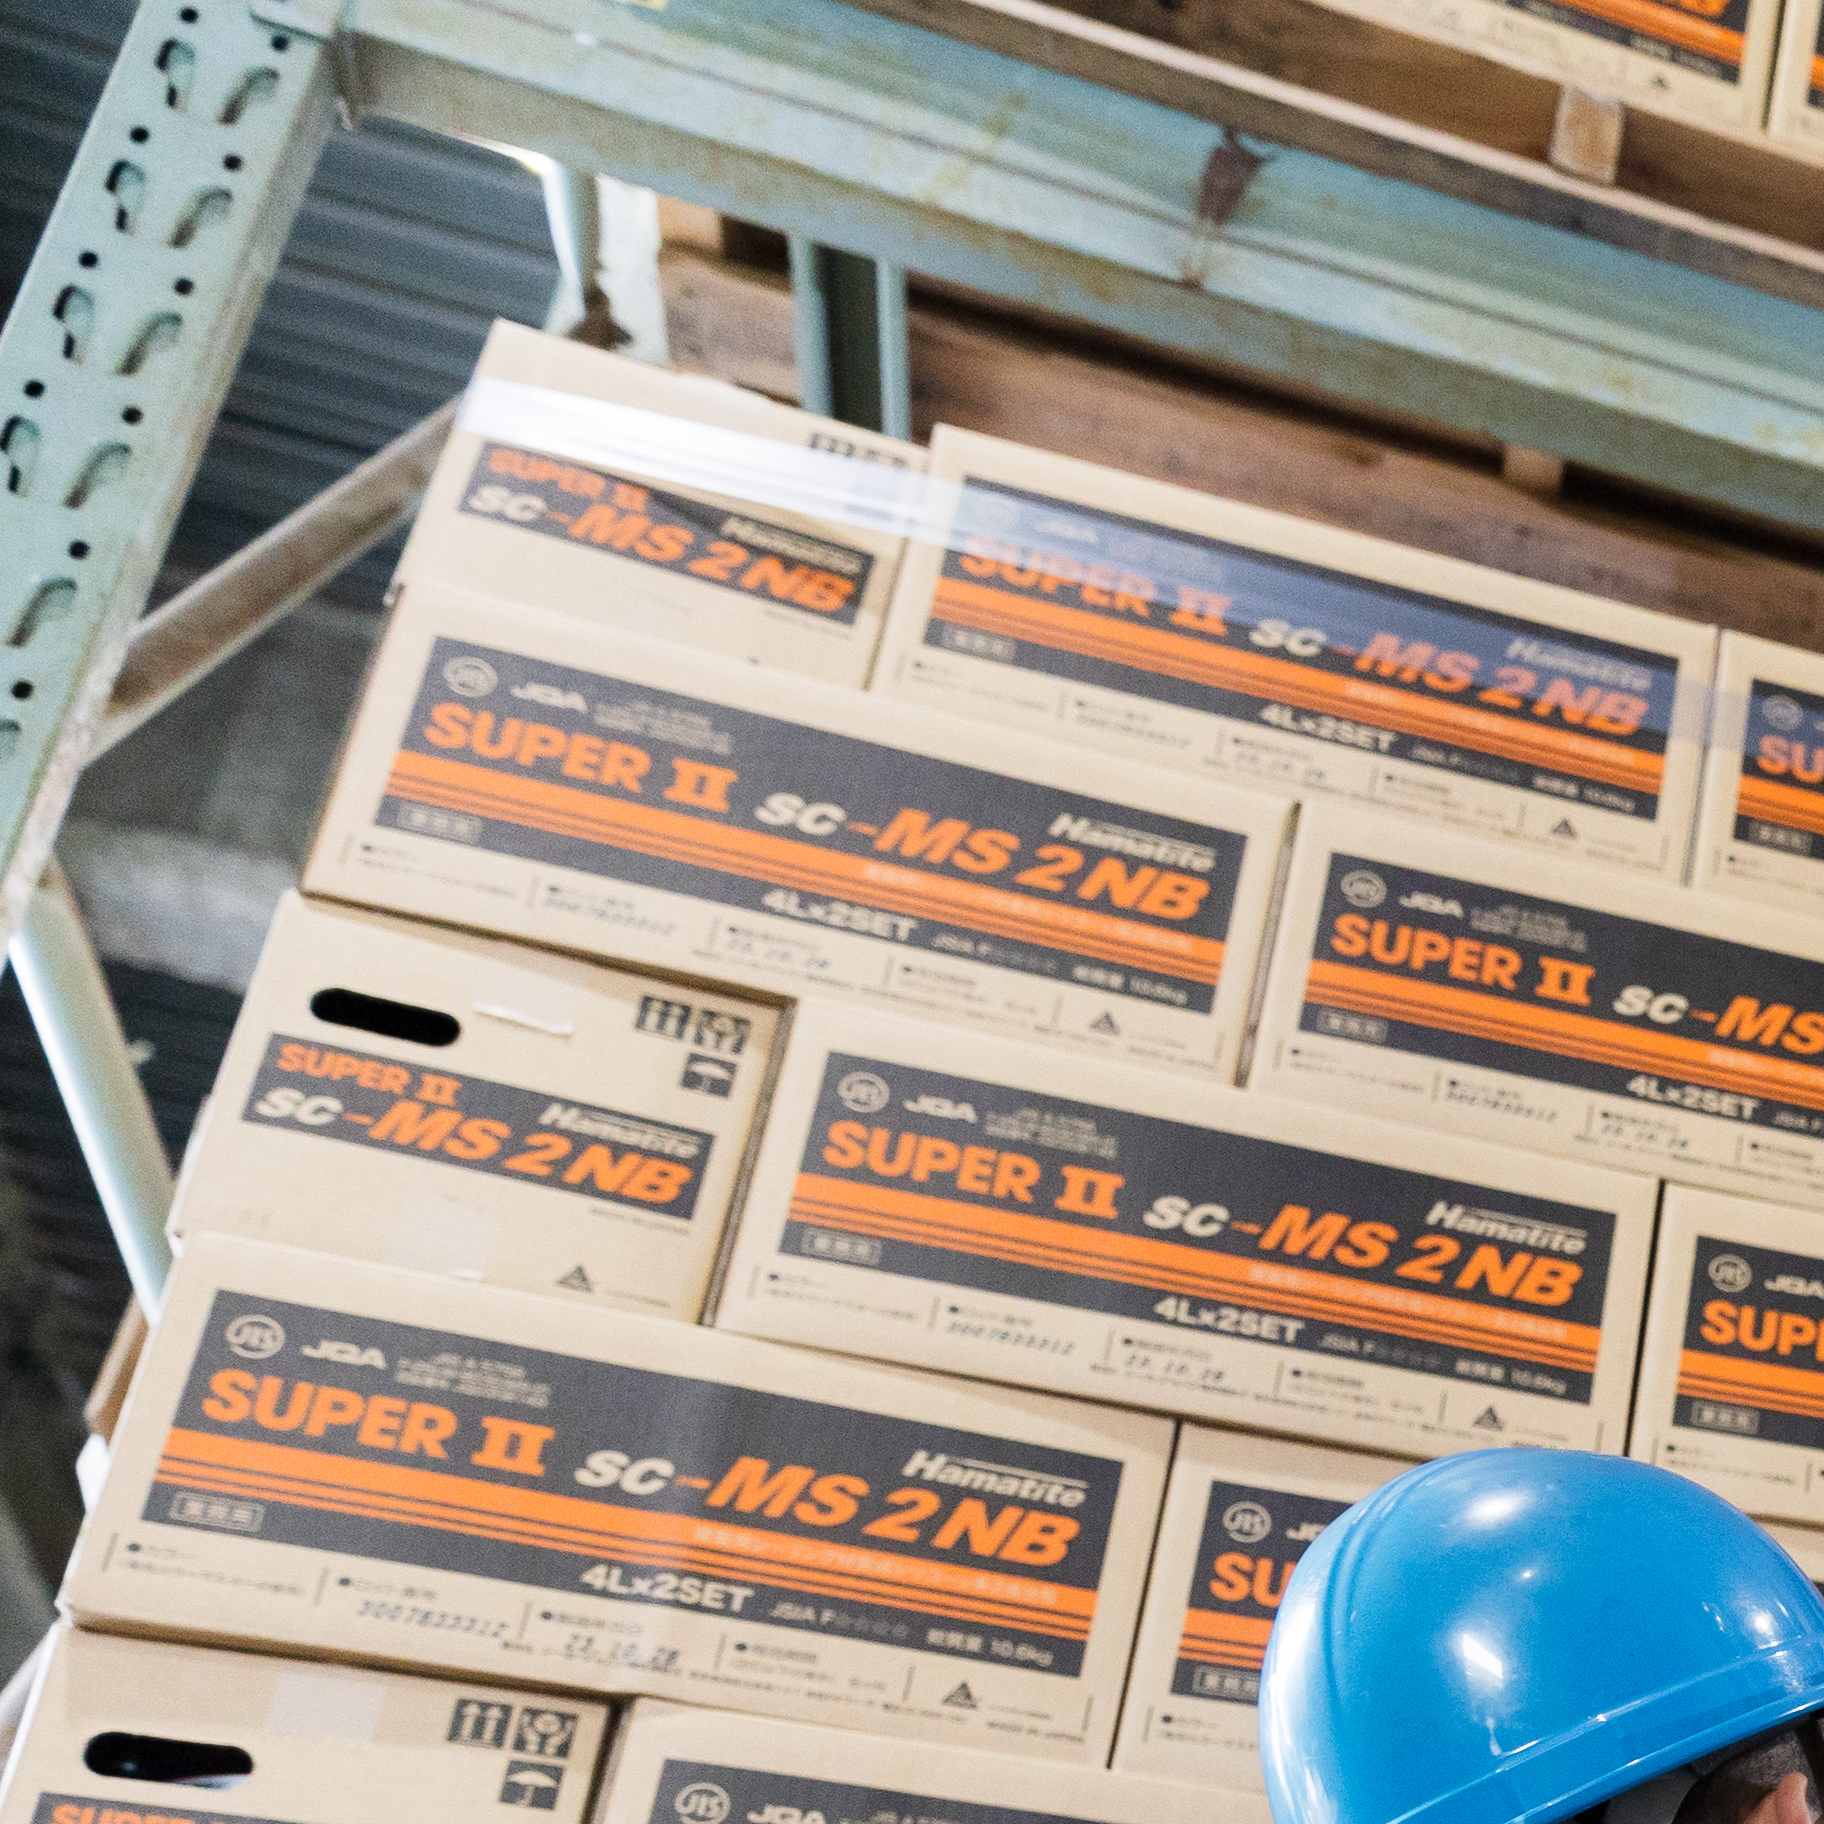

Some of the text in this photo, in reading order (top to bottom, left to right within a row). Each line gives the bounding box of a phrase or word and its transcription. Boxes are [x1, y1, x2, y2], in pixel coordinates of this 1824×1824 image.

[421, 697, 651, 793] SUPER
[1048, 811, 1219, 877] Hamatite
[1328, 909, 1516, 990] SUPER
[276, 1043, 414, 1097] SUPER
[540, 1104, 700, 1162] Hamatite
[817, 1116, 1040, 1206] SUPER
[1053, 1165, 1131, 1223] II
[1425, 1201, 1590, 1260] Hamatite
[298, 1337, 391, 1372] JQA
[195, 1362, 456, 1461] SUPER
[467, 1414, 561, 1480] II
[901, 1449, 1091, 1514] Hamatite
